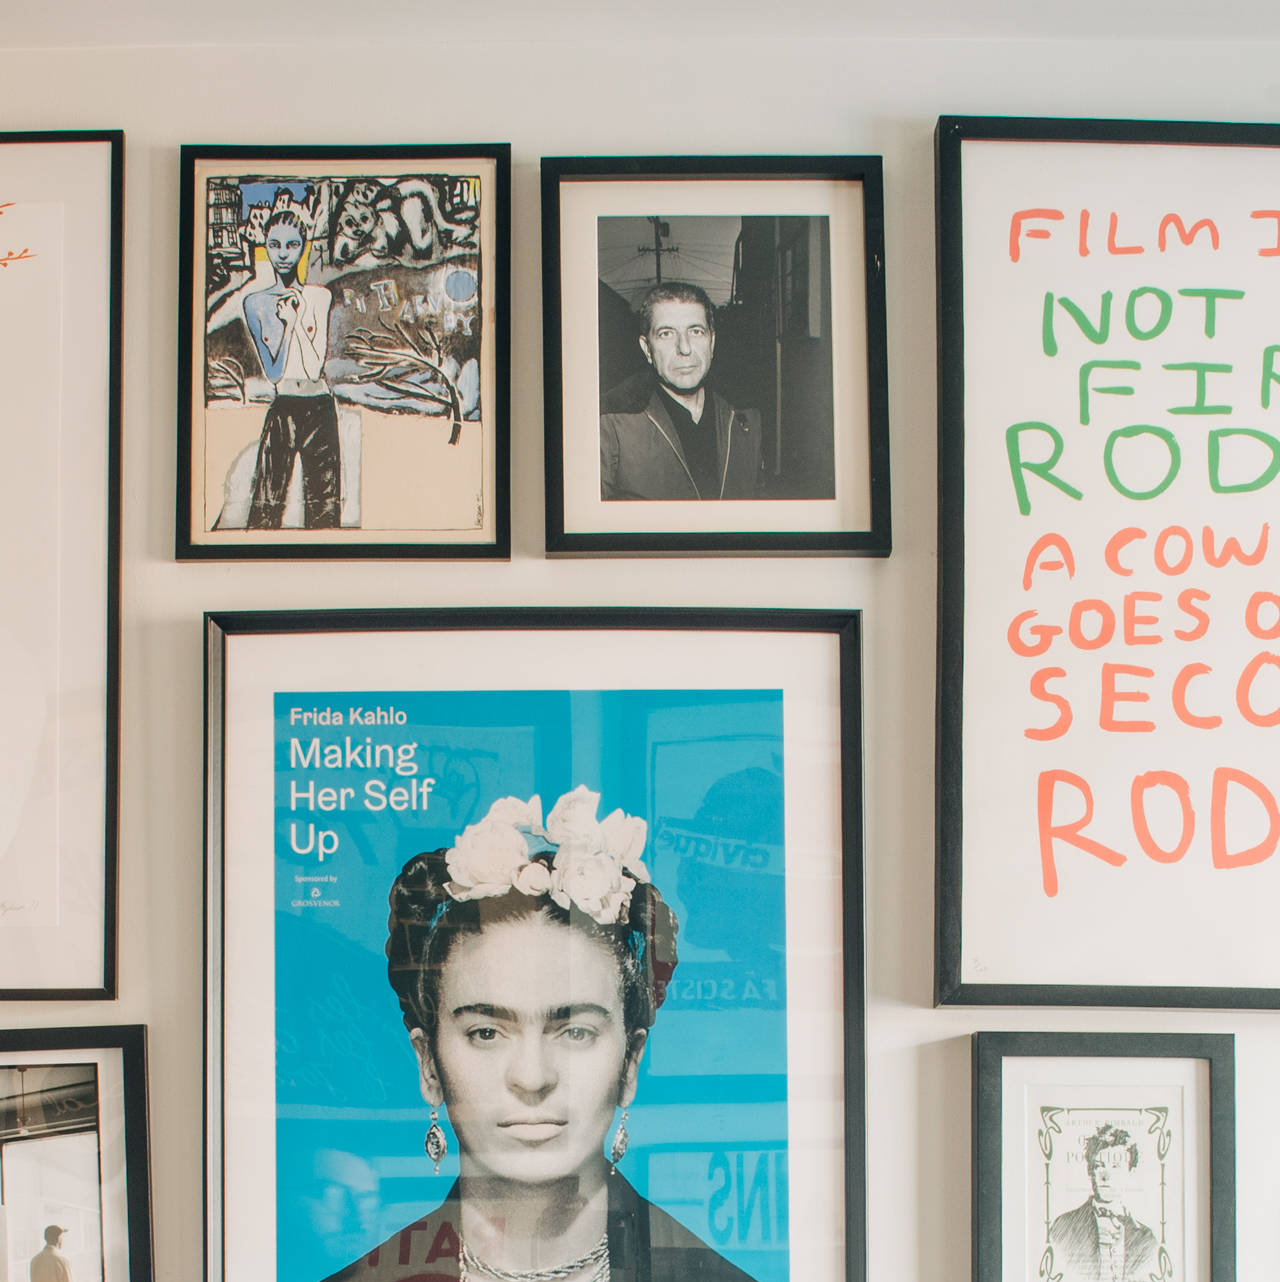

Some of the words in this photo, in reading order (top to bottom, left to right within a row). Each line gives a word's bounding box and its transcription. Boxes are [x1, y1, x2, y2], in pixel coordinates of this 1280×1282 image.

[1009, 209, 1219, 262] FILM
[1044, 286, 1244, 356] NOT
[1023, 533, 1075, 591] A
[1008, 589, 1210, 657] GOES
[291, 708, 343, 725] Frida
[350, 707, 406, 725] Kahlo
[291, 736, 418, 775] Making
[291, 781, 355, 811] Her
[364, 778, 435, 811] Self
[291, 824, 338, 861] Up
